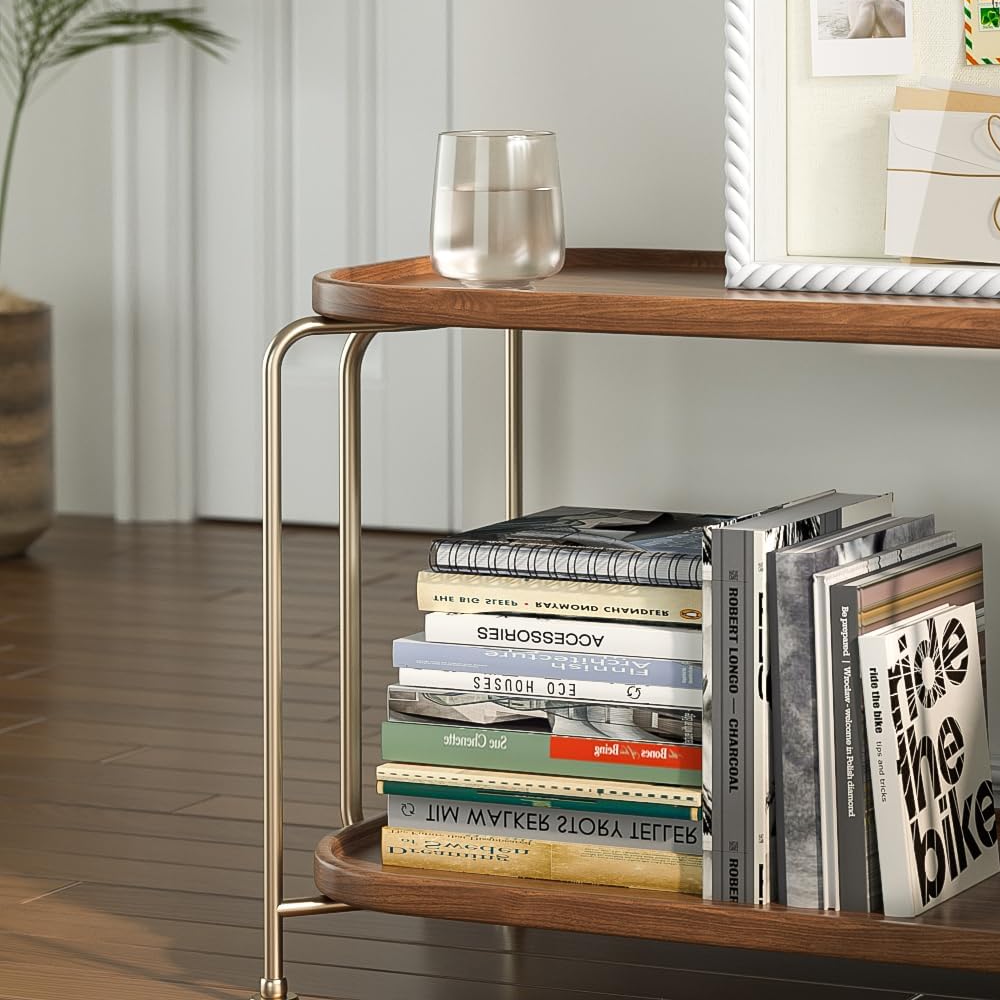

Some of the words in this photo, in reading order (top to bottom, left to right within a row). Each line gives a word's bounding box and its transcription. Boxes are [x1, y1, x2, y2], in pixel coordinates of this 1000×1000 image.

[728, 588, 739, 643] ROBERT
[841, 606, 849, 617] Be
[477, 626, 605, 647] ACCESSORIES
[840, 618, 851, 656] prepared
[484, 649, 651, 669] Architecture
[551, 662, 649, 676] Finnish
[728, 648, 739, 694] LONGO
[473, 676, 534, 693] HOUSES
[869, 667, 880, 689] ride
[887, 617, 970, 734] ride
[547, 682, 576, 696] ECO
[872, 691, 881, 708] the
[845, 708, 853, 746] welcome
[873, 710, 883, 734] bike
[728, 718, 739, 793] CHARCOAL
[846, 747, 854, 755] in
[846, 756, 855, 780] Polish
[878, 759, 886, 776] and
[896, 716, 965, 821] the
[847, 781, 856, 817] diamond
[880, 778, 888, 802] tricks
[910, 779, 998, 907] bike
